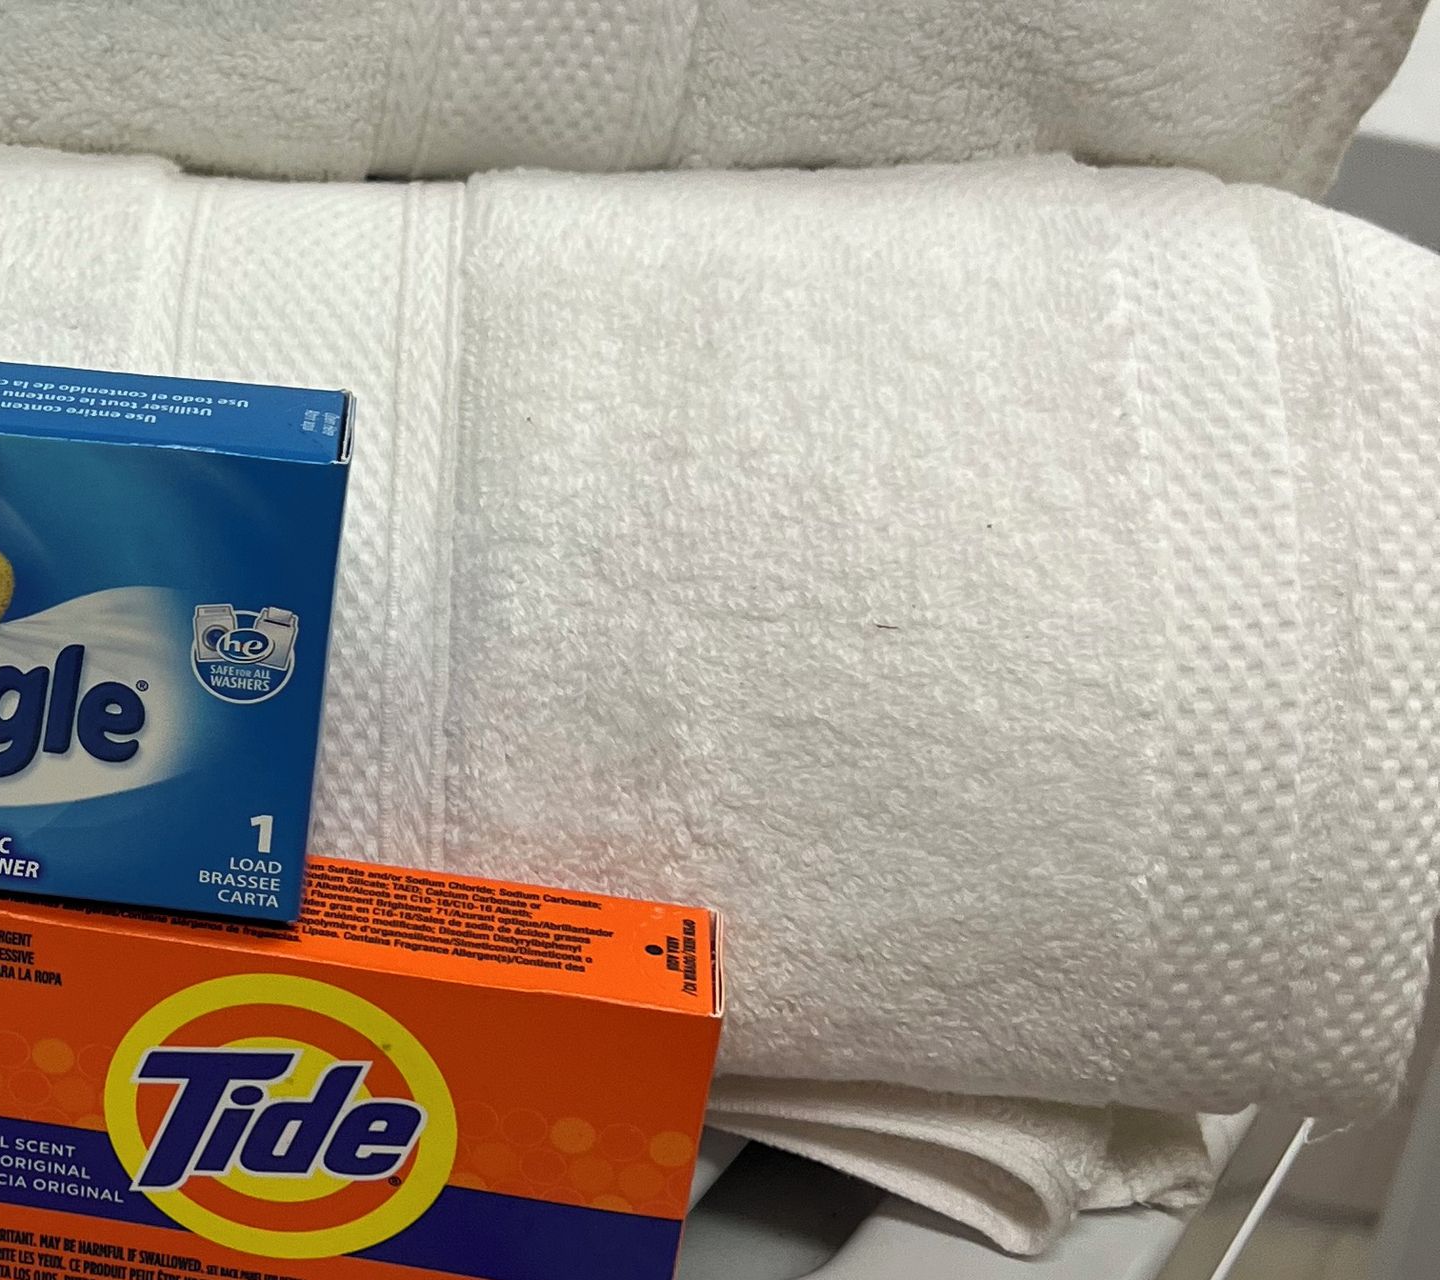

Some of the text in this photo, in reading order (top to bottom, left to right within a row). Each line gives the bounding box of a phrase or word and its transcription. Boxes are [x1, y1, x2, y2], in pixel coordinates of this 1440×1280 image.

[12, 379, 29, 389] la
[32, 381, 55, 390] de
[58, 384, 148, 398] contenido
[2, 389, 75, 402] contenu
[78, 396, 95, 406] le
[99, 398, 137, 409] tout
[150, 392, 168, 401] el
[171, 394, 213, 404] todo
[217, 398, 249, 408] Use
[65, 406, 121, 418] entire
[124, 412, 156, 423] Use
[209, 664, 271, 680] SAFE FOR ALL
[209, 674, 271, 692] WASHERS
[250, 814, 274, 853] 1
[229, 856, 282, 874] LOAD
[198, 869, 281, 892] BRASSEE
[217, 888, 279, 909] CARTA
[18, 967, 31, 981] LA
[34, 970, 61, 985] ROPA
[130, 1046, 427, 1192] Tide
[15, 1138, 74, 1156] SCENT
[0, 1155, 89, 1178] ORIGINAL
[33, 1178, 123, 1202] ORIGINAL
[39, 1235, 60, 1249] MAY
[63, 1238, 75, 1252] BE
[78, 1240, 124, 1260] HARMFUL
[139, 1250, 203, 1272] SWALLOWED.
[18, 1250, 34, 1264] LES
[37, 1253, 65, 1269] YEUX.
[69, 1258, 80, 1272] CE
[83, 1260, 126, 1279] PRODUIT
[13, 1266, 30, 1280] LOS
